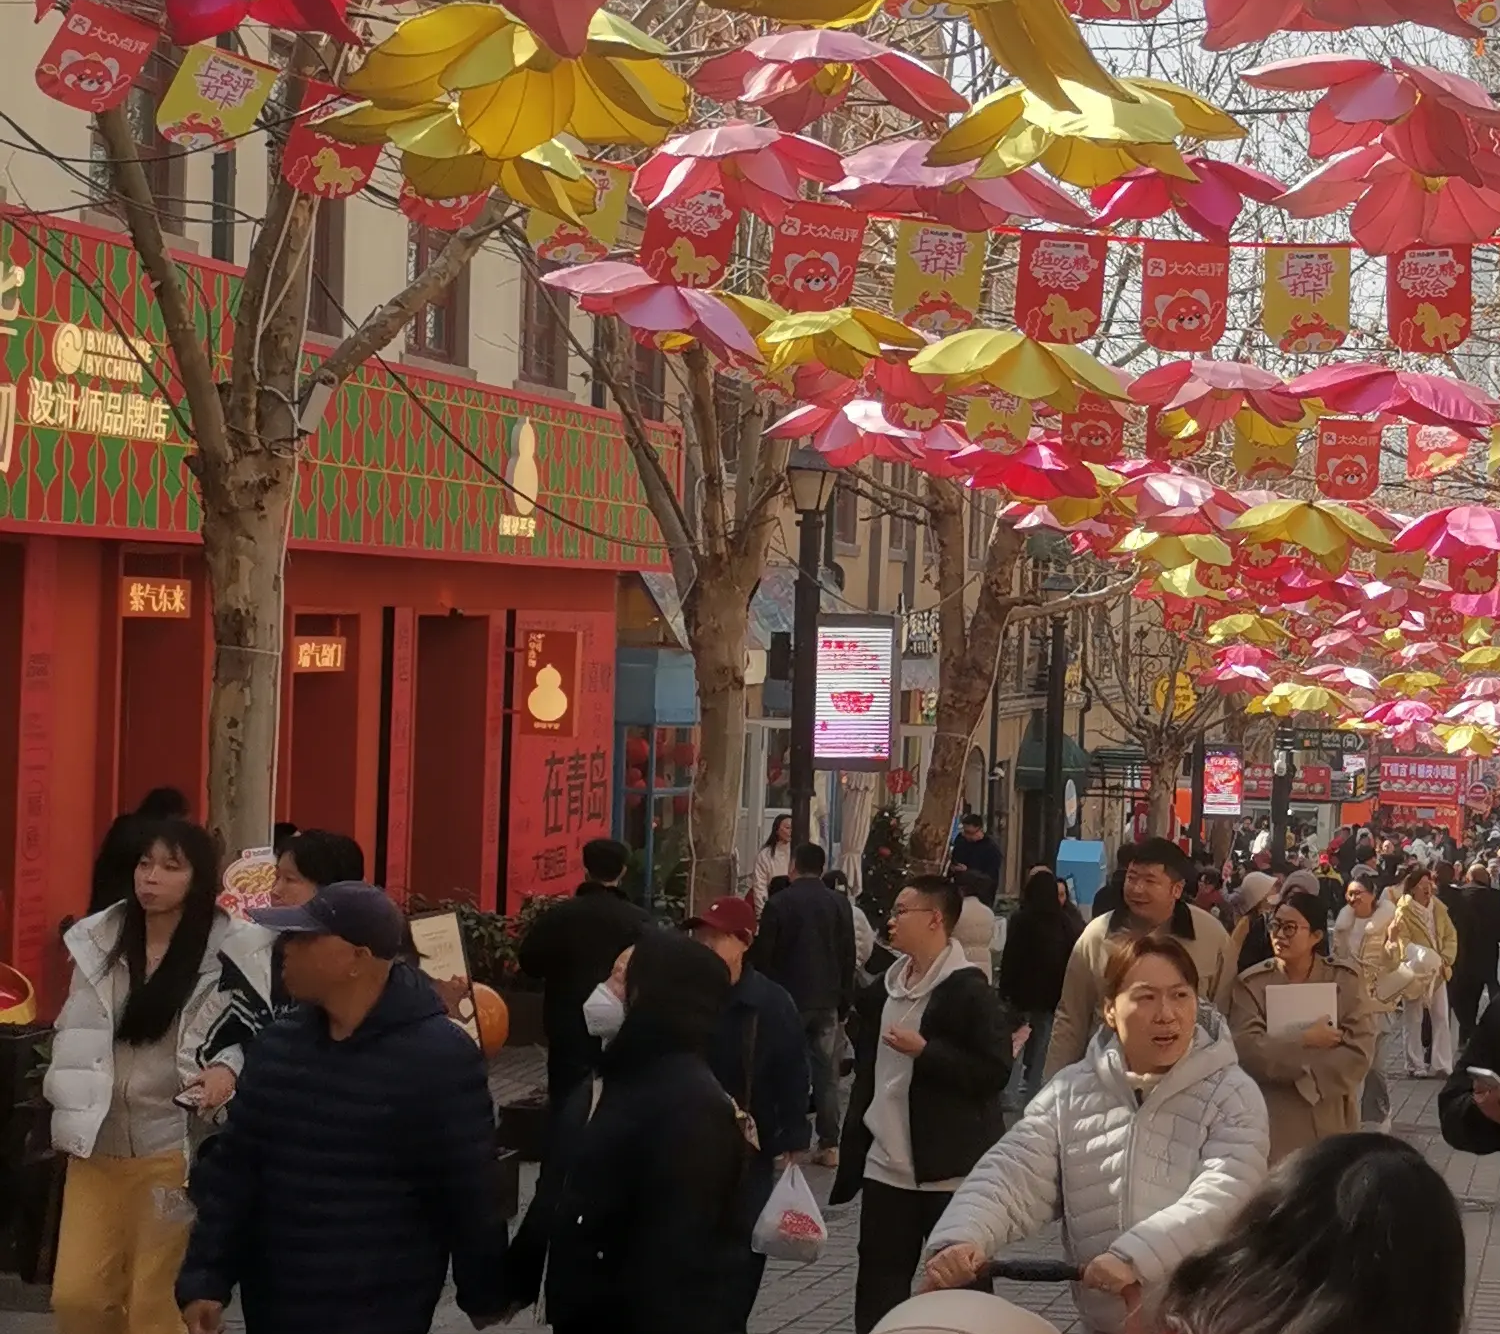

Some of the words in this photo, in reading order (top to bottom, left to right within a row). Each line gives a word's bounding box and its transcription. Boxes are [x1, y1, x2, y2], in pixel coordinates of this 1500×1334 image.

[91, 25, 149, 55] 大众点评
[195, 61, 256, 97] 上点评
[801, 222, 859, 243] 大众点评
[911, 235, 968, 265] 上点评
[922, 255, 956, 282] 打卡
[1167, 262, 1225, 277] 大众点评
[1277, 260, 1335, 286] 上点评
[1290, 279, 1326, 305] 打卡
[105, 357, 143, 383] CHINA
[29, 376, 170, 440] 设计师品牌店
[129, 583, 186, 613] 紫气东来
[543, 746, 607, 837] 在青岛
